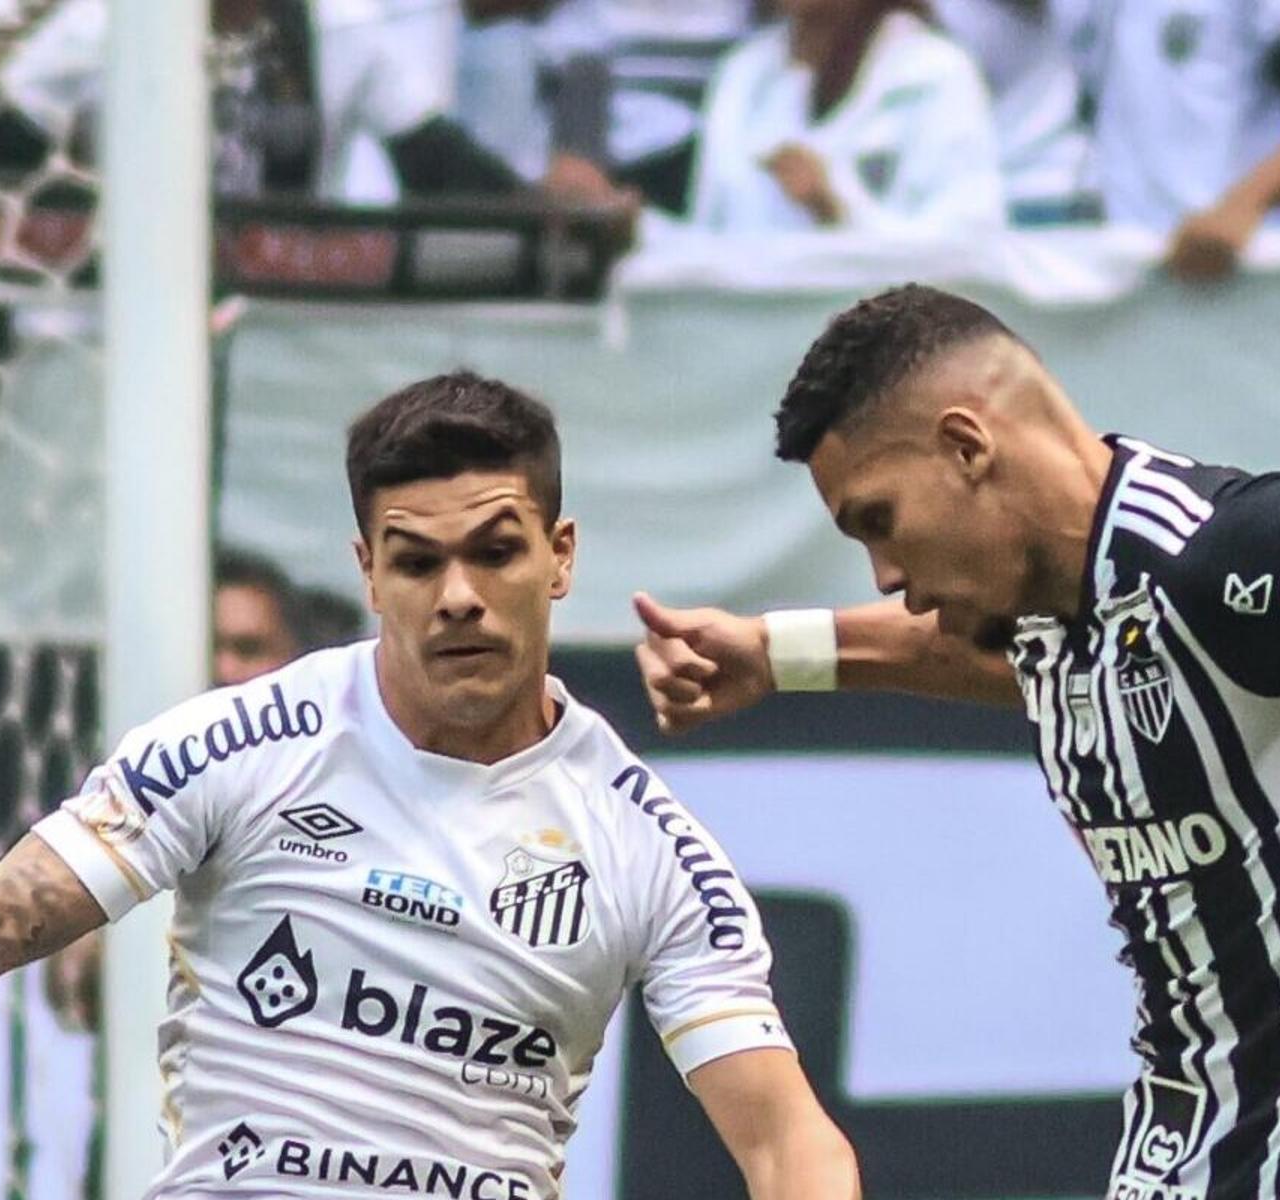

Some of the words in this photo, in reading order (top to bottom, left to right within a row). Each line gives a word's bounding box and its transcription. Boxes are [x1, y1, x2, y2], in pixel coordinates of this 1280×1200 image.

[119, 682, 324, 817] Kicaldo
[278, 838, 348, 864] umbro
[363, 887, 460, 928] BOND
[341, 968, 558, 1067] blaze
